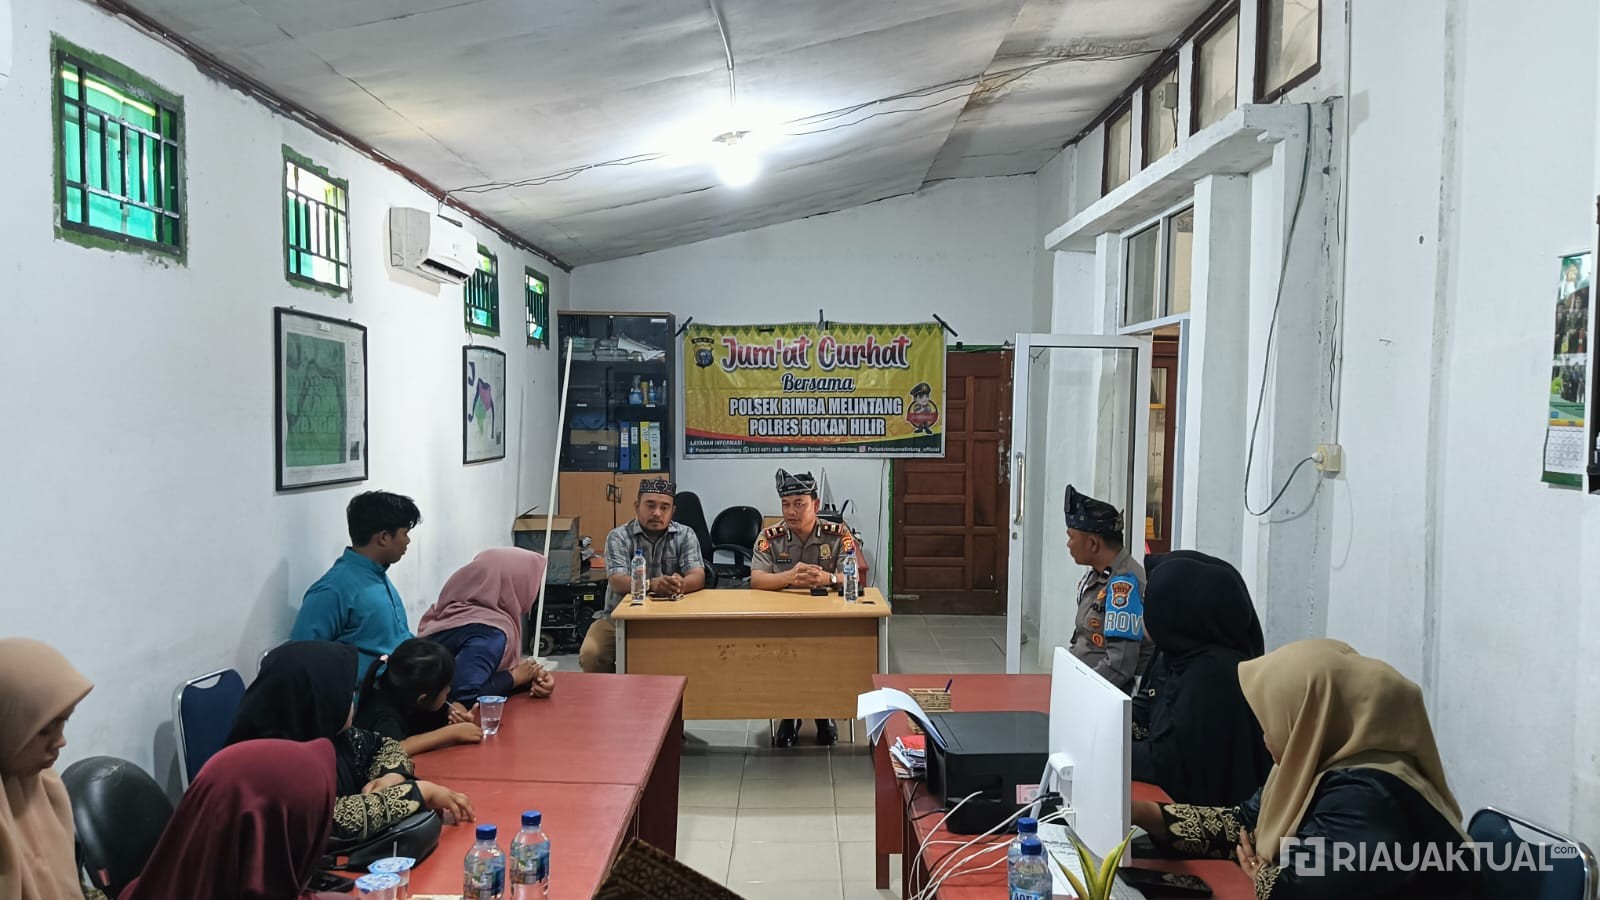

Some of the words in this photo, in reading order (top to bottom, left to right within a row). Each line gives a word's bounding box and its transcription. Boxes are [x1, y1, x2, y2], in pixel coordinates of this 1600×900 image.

[722, 336, 811, 371] Jum'at
[818, 336, 910, 371] Curhat
[782, 374, 855, 392] Bersama
[729, 397, 779, 416] POLSEK
[782, 397, 826, 416] RIMBA
[828, 396, 902, 415] MELINTANG
[749, 418, 800, 437] POLRES
[802, 417, 847, 436] ROKAN
[850, 417, 886, 436] HILIR
